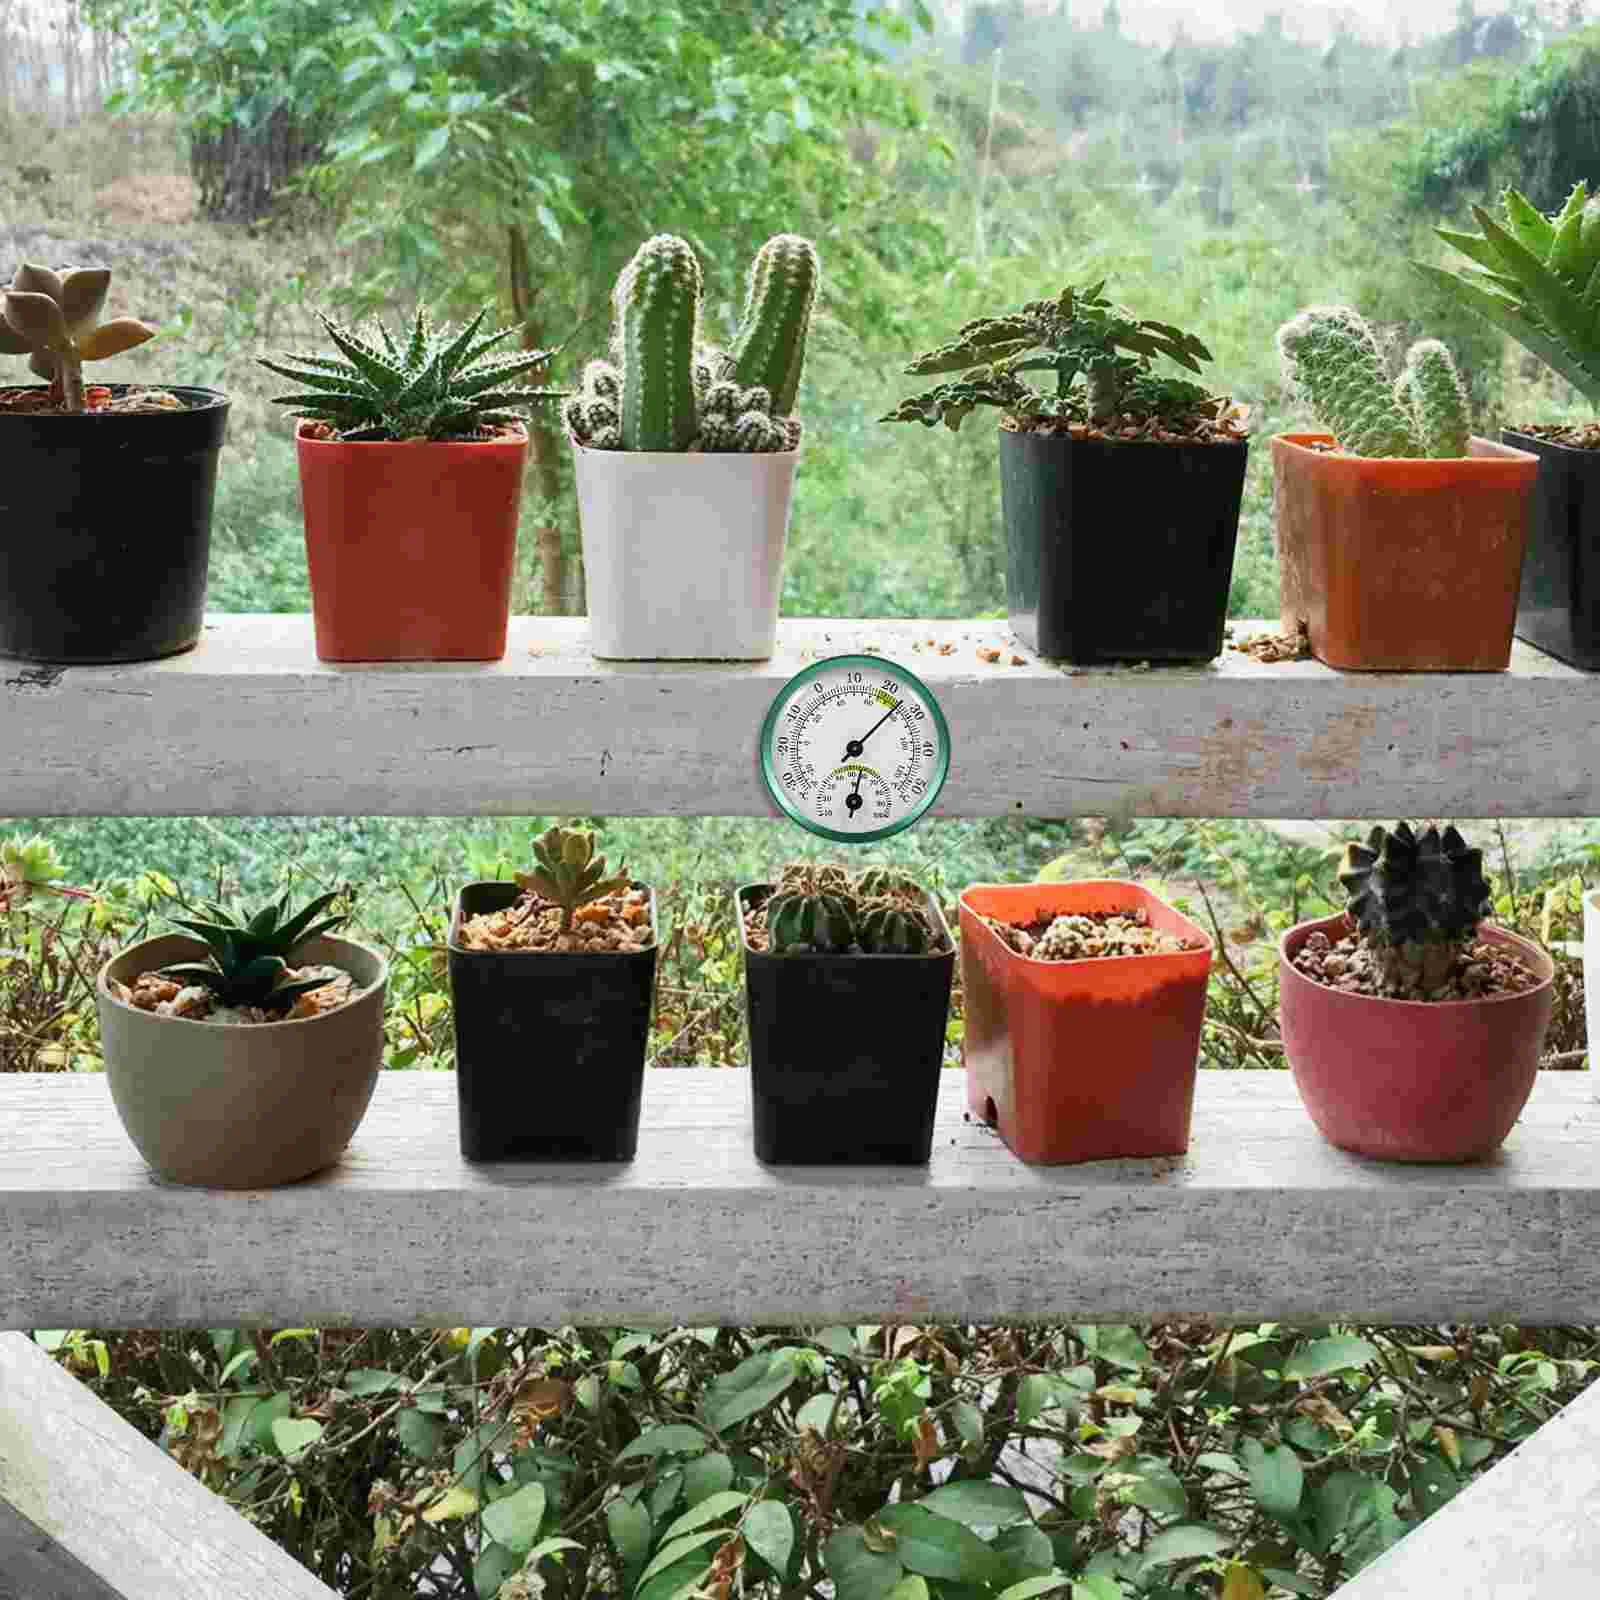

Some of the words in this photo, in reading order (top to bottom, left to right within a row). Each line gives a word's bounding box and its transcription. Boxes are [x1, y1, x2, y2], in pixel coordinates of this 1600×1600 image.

[847, 672, 862, 684] 10
[814, 682, 824, 693] 0
[881, 680, 898, 694] 20
[910, 704, 925, 720] 30
[922, 741, 934, 757] 40
[911, 778, 926, 793] 50
